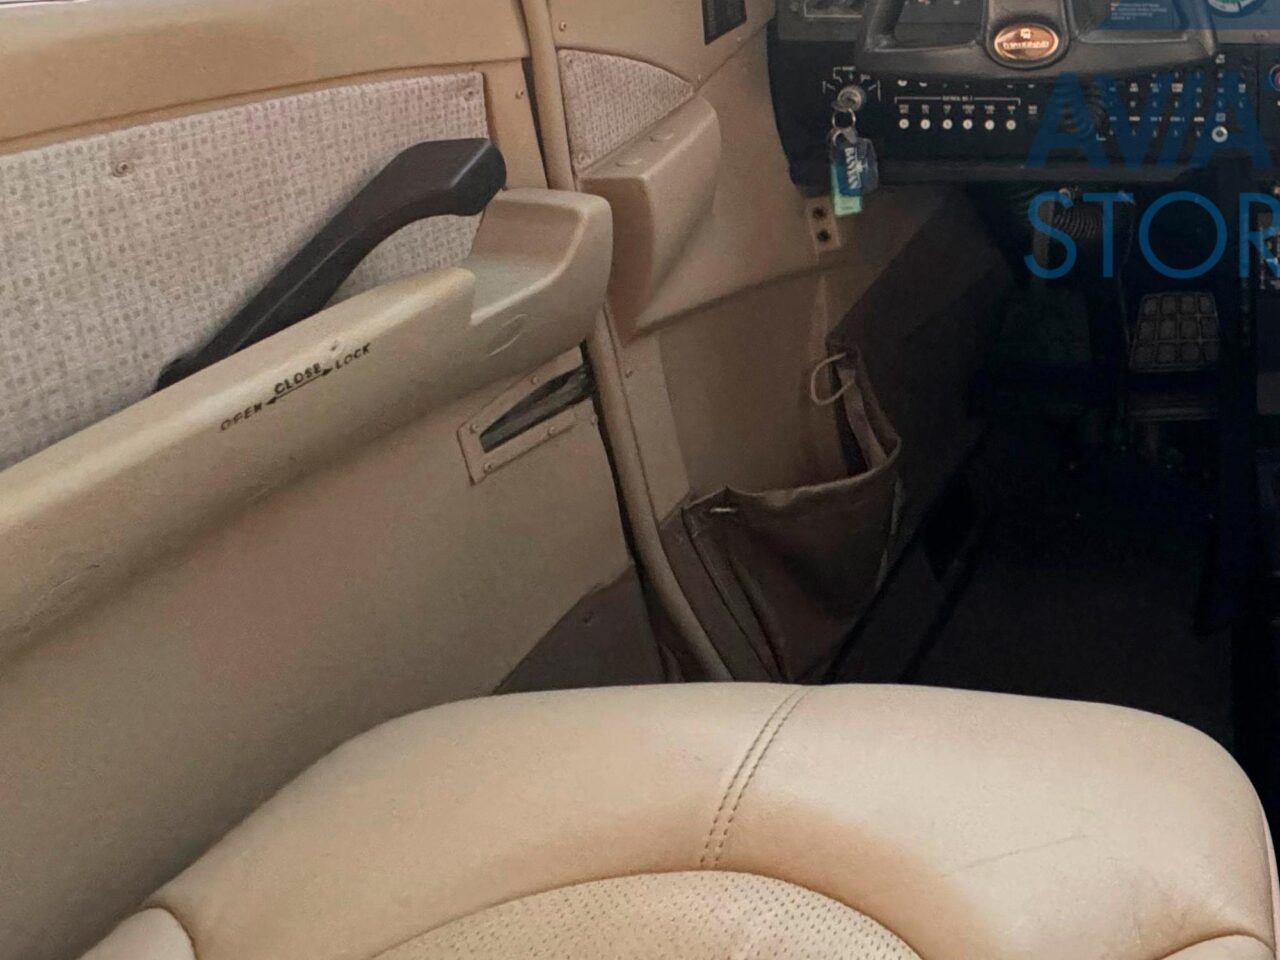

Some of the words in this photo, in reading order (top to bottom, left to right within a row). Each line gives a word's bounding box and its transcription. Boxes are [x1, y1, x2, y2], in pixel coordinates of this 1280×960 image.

[220, 401, 263, 432] OPEN
[273, 362, 322, 395] CLOSE
[335, 342, 372, 370] LOCK
